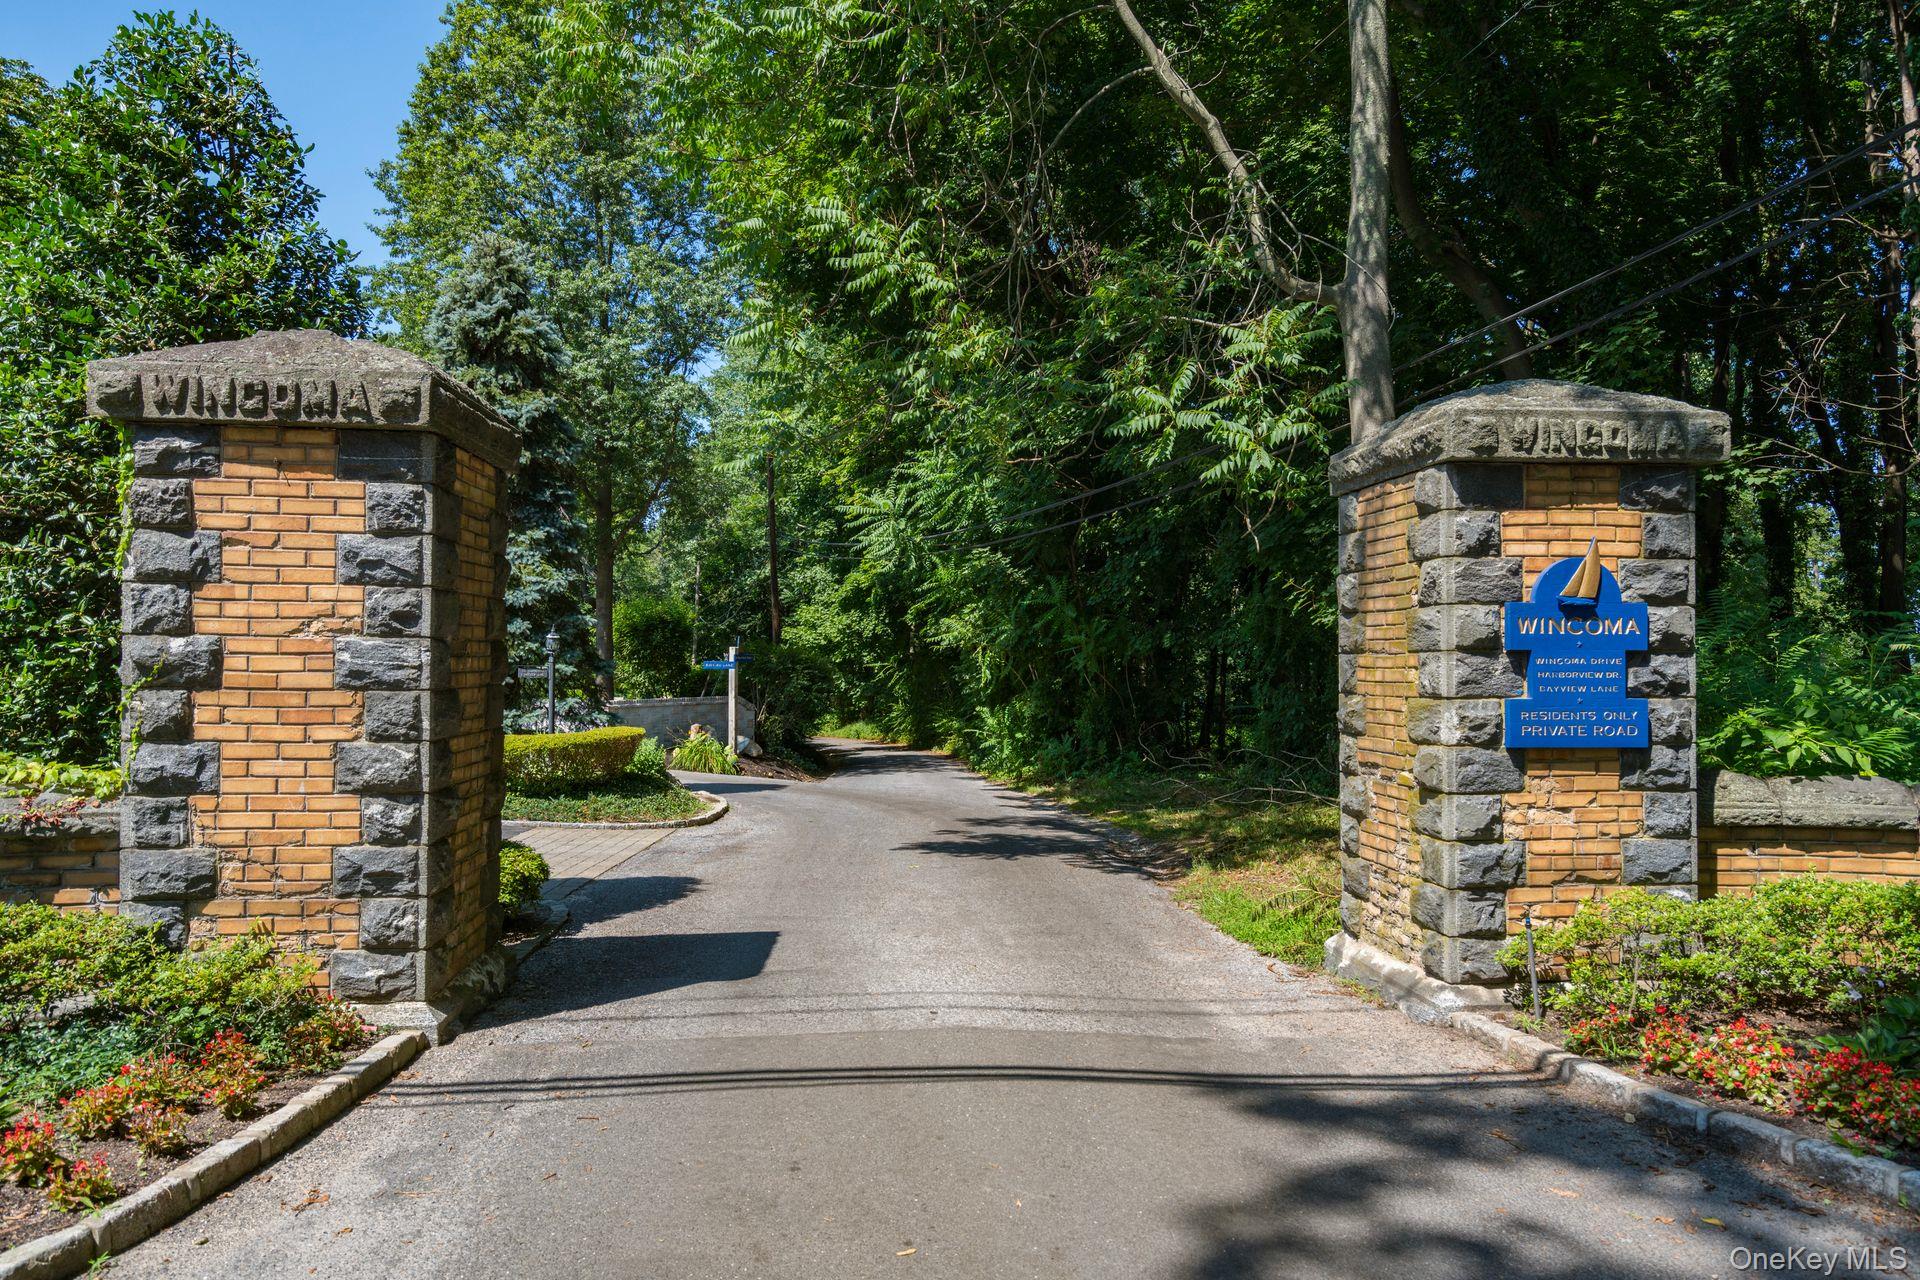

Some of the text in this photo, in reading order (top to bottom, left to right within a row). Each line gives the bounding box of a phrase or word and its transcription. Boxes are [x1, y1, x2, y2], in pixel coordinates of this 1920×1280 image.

[153, 373, 376, 421] WINCOMA
[1512, 416, 1689, 460] WINCOMA
[1518, 617, 1640, 635] WINCOMA
[1535, 657, 1622, 665] WINCOMA DRIVE
[1537, 671, 1604, 679] HARBORVIEW
[1590, 685, 1620, 693] LANE
[1520, 711, 1639, 721] RESIDENTS ONLY
[1520, 725, 1639, 737] PRIVATE ROAD
